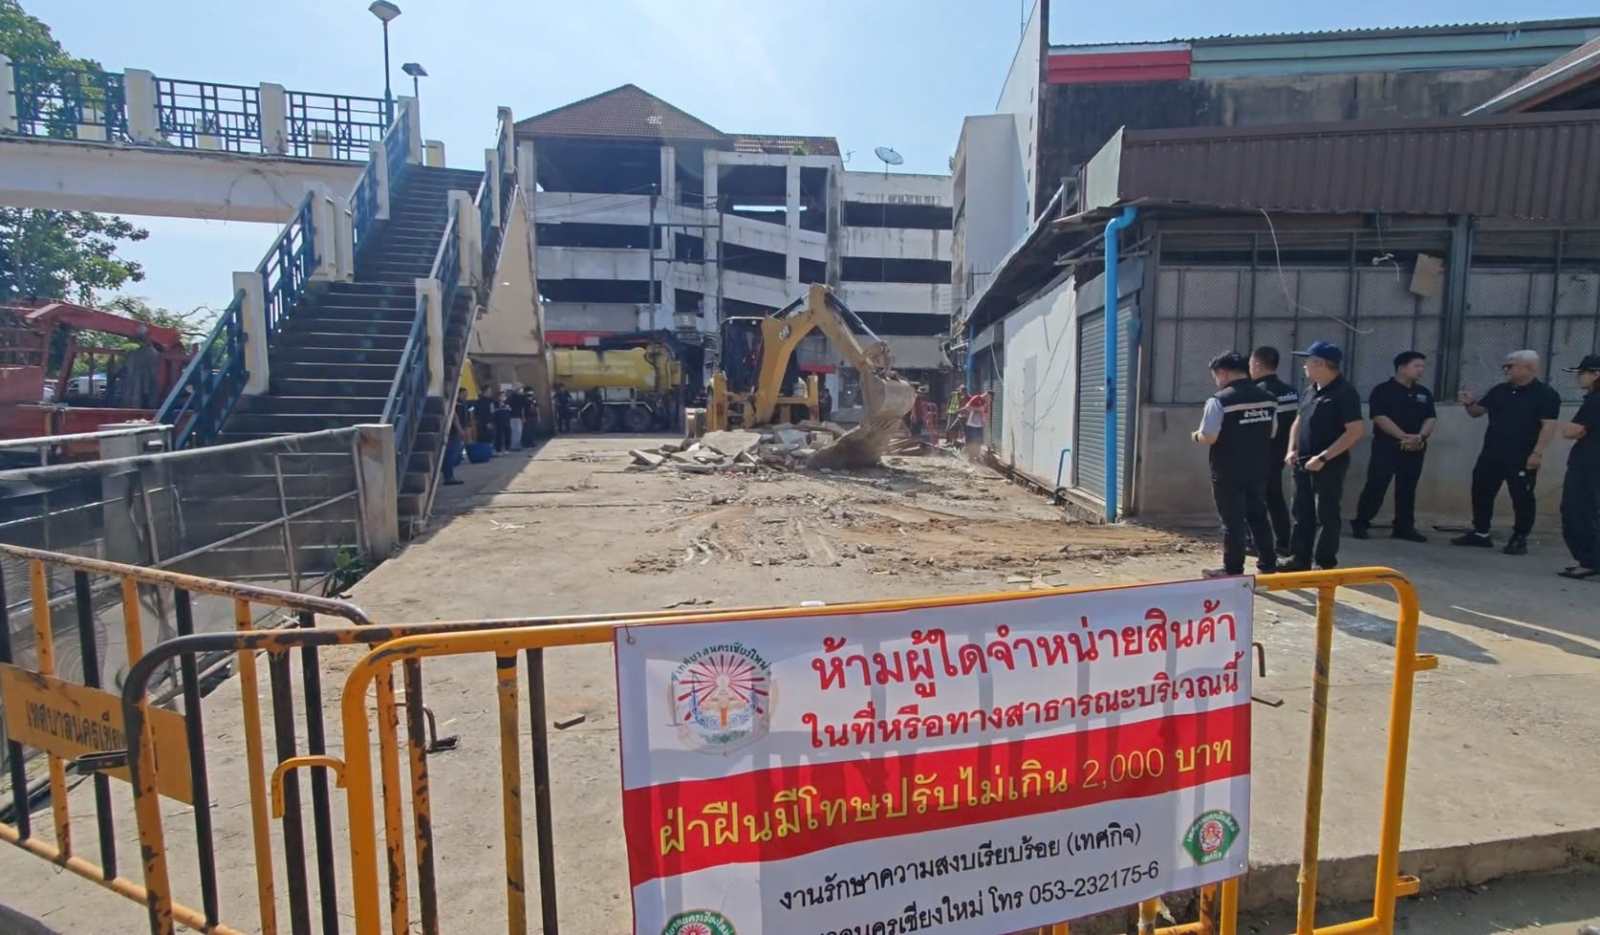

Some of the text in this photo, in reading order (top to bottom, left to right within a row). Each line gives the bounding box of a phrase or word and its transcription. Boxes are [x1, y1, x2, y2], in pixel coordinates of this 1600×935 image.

[811, 600, 1237, 698] ห้ามผู้ใดจำหน่ายสินค้า
[802, 651, 1245, 749] ในที่หรือทางสาธารณะบริเวณนี้
[659, 739, 1232, 856] ฝ่าฝืนมีโทษปรับไม่เกิน 2,000 บาท
[779, 834, 1062, 911] งานรักษาความสงบเรียบร้อย
[1065, 822, 1142, 861] (เทศกิจ)
[989, 886, 1024, 913] โทร
[1028, 861, 1160, 906] 053-232175-6
